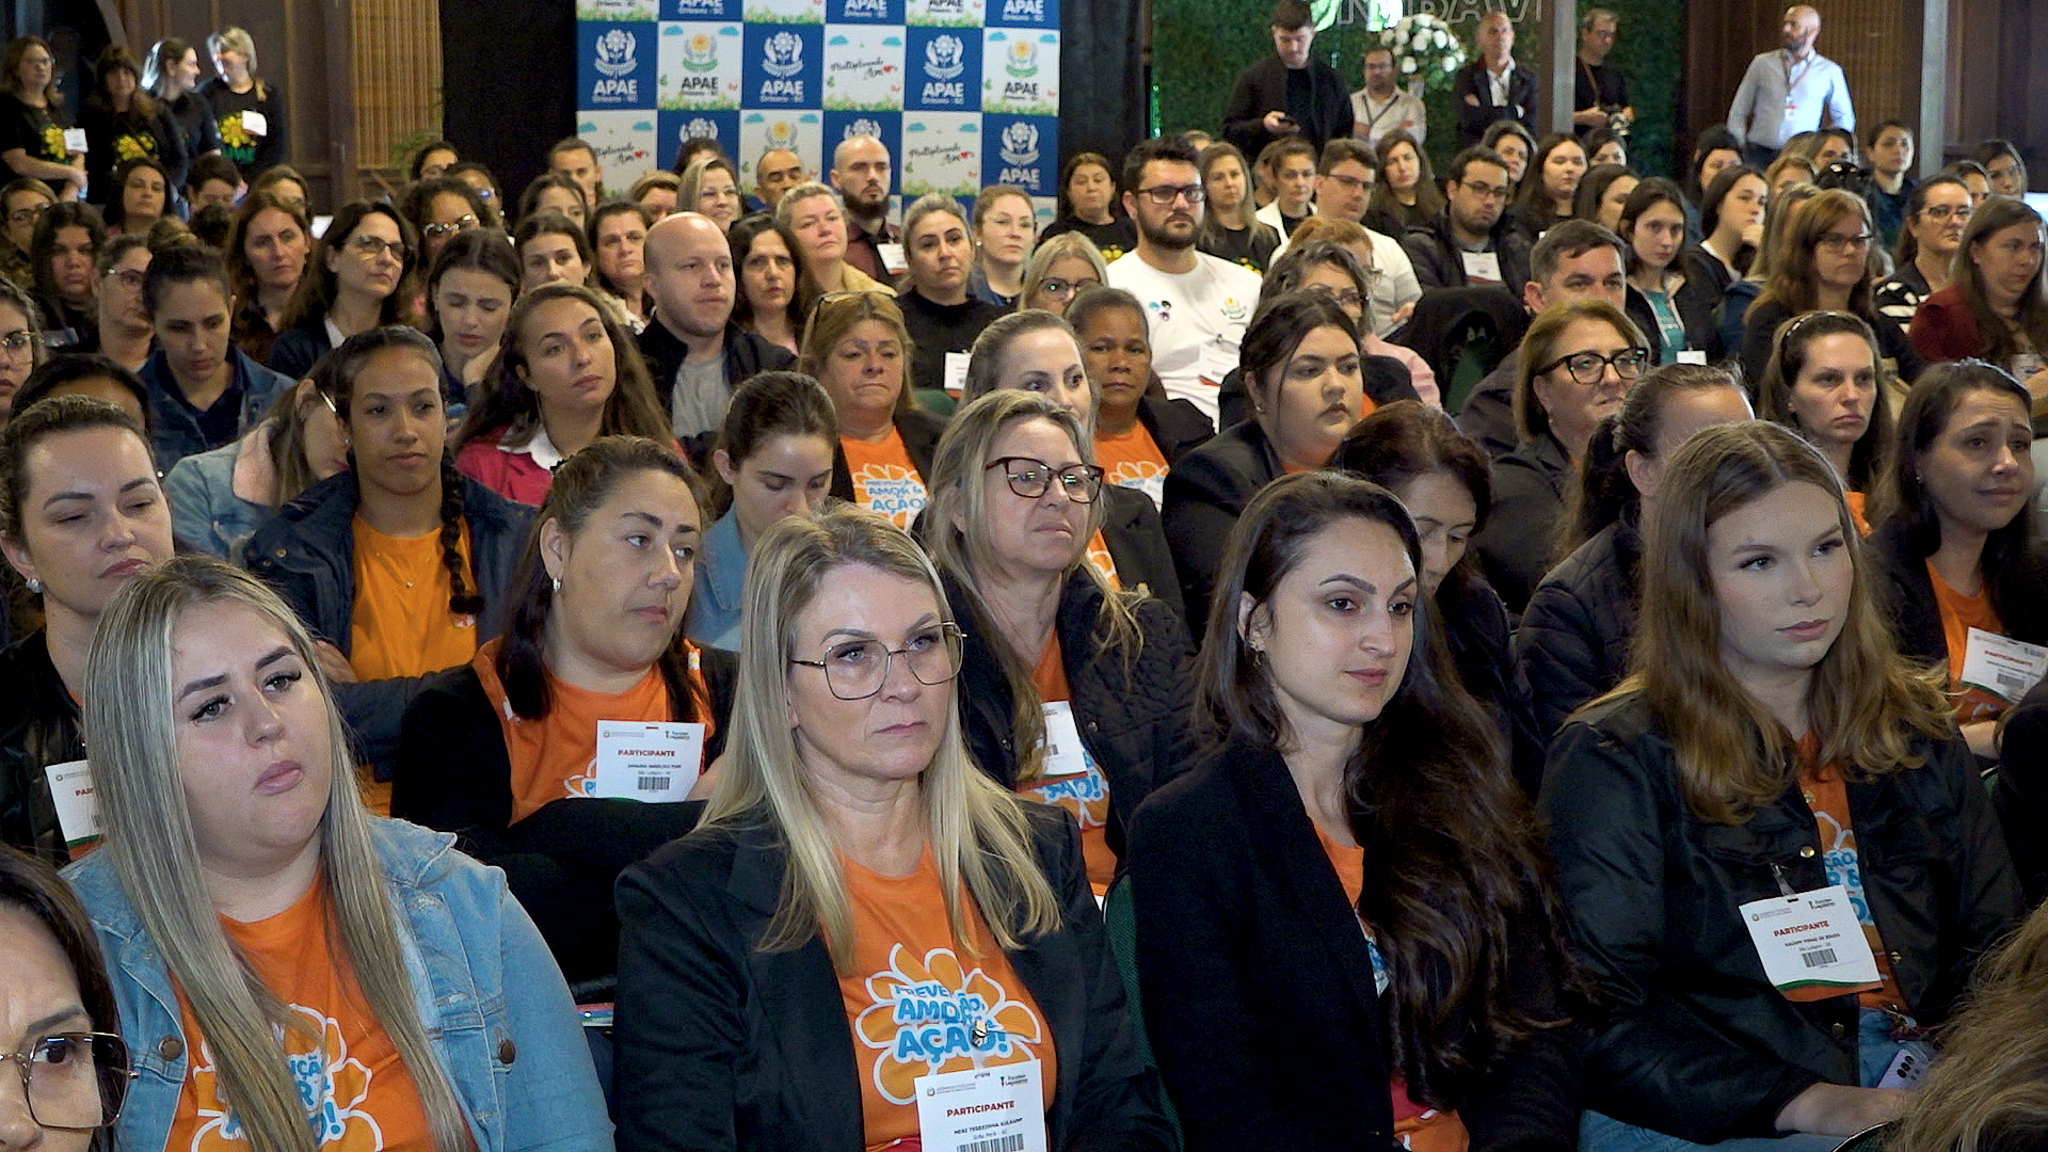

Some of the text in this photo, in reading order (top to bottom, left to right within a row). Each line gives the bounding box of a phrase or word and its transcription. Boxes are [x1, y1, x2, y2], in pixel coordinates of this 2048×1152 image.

[1003, 0, 1044, 14] APAE
[594, 79, 638, 95] APAE
[682, 77, 719, 90] APAE
[760, 80, 804, 96] APAE
[922, 82, 964, 97] APAE
[1005, 81, 1039, 95] APAE
[999, 168, 1041, 184] APAE
[617, 749, 676, 758] PARTICIPANTE
[1773, 920, 1831, 938] PARTICIPANTE
[898, 1021, 1009, 1064] AÇÃO!
[946, 1100, 1015, 1118] PARTICIPANTE
